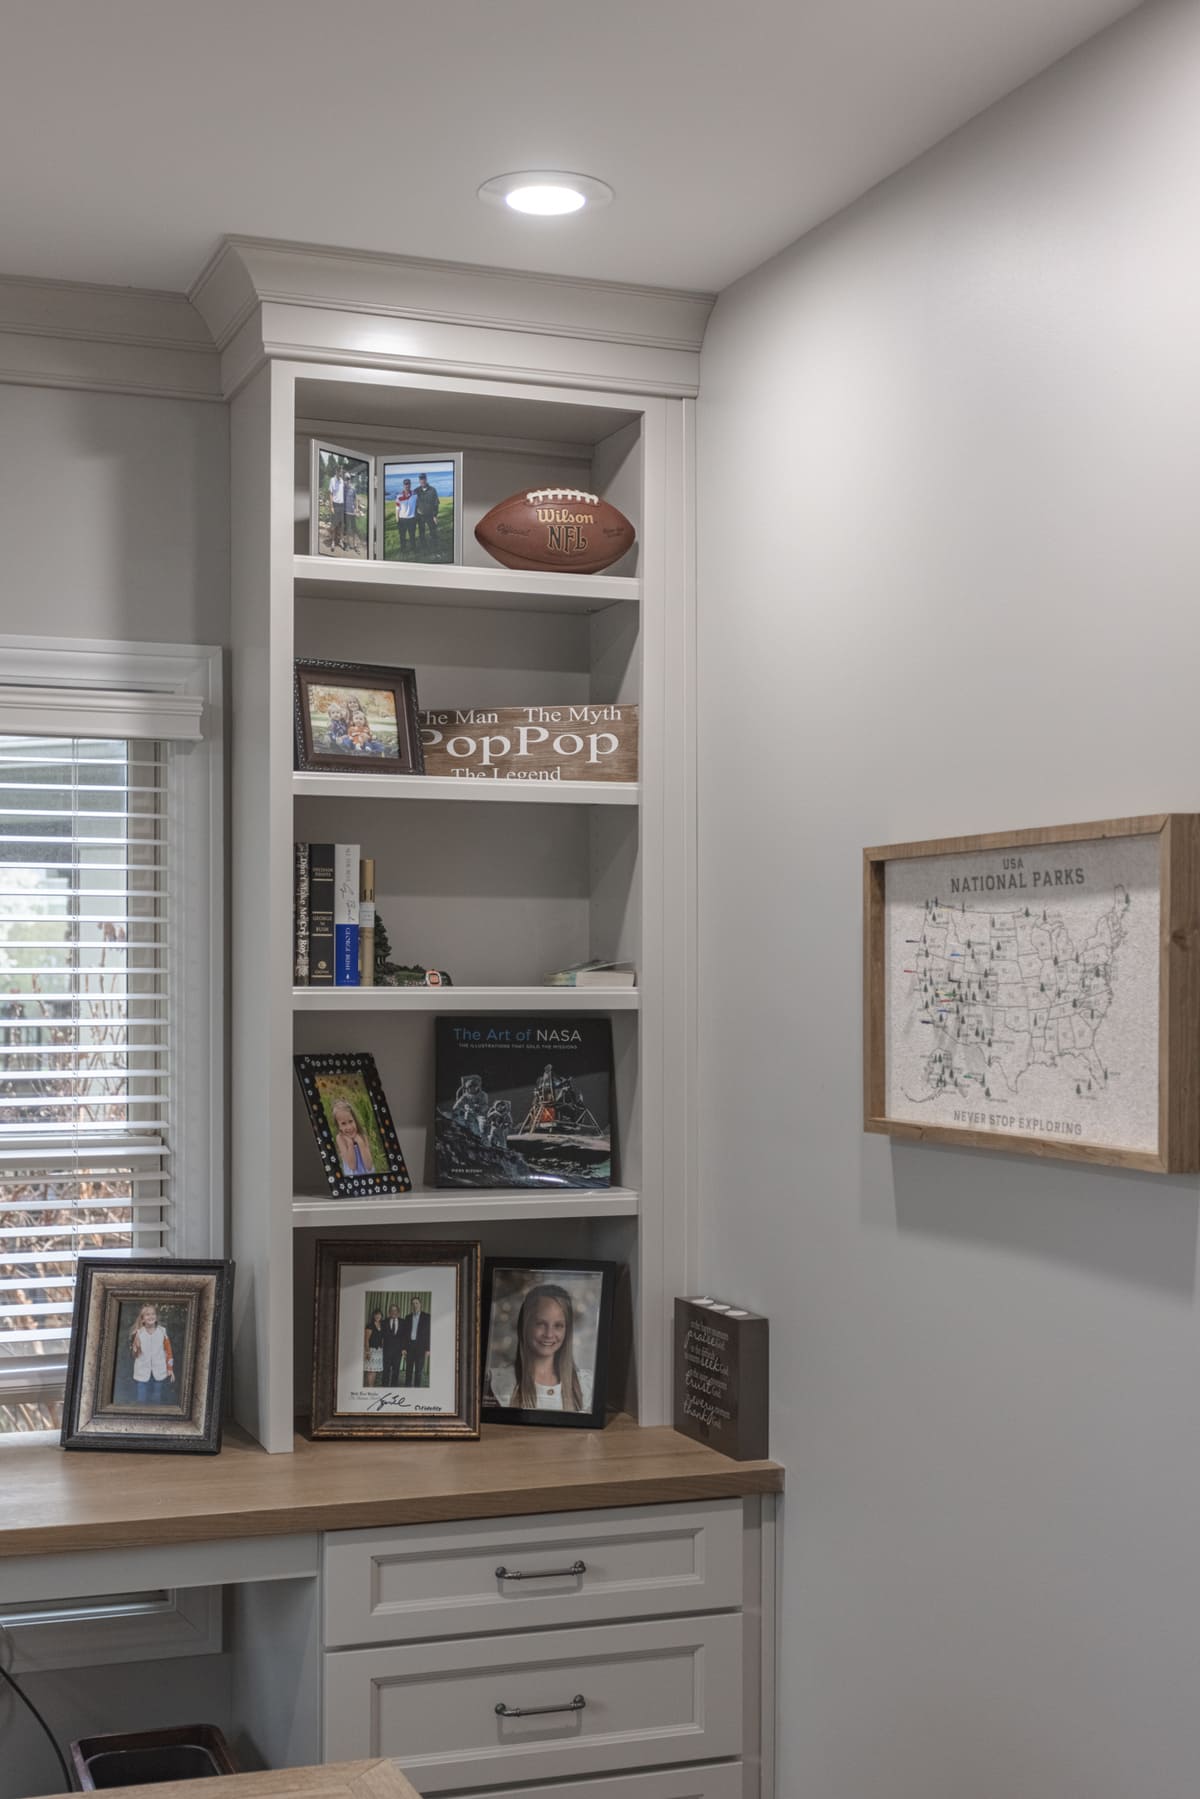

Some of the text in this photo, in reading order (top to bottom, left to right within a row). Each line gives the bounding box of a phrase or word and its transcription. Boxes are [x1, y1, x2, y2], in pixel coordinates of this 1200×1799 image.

[536, 508, 594, 524] Wilson
[547, 525, 588, 554] NFL
[455, 710, 498, 725] Man
[523, 706, 561, 723] The
[569, 706, 622, 725] Myth
[1002, 858, 1024, 870] USA
[950, 868, 1085, 893] NATIONAL PARKS
[453, 1028, 582, 1042] The Art of NASA
[953, 1110, 1082, 1136] NEVER STOP EXPLORING
